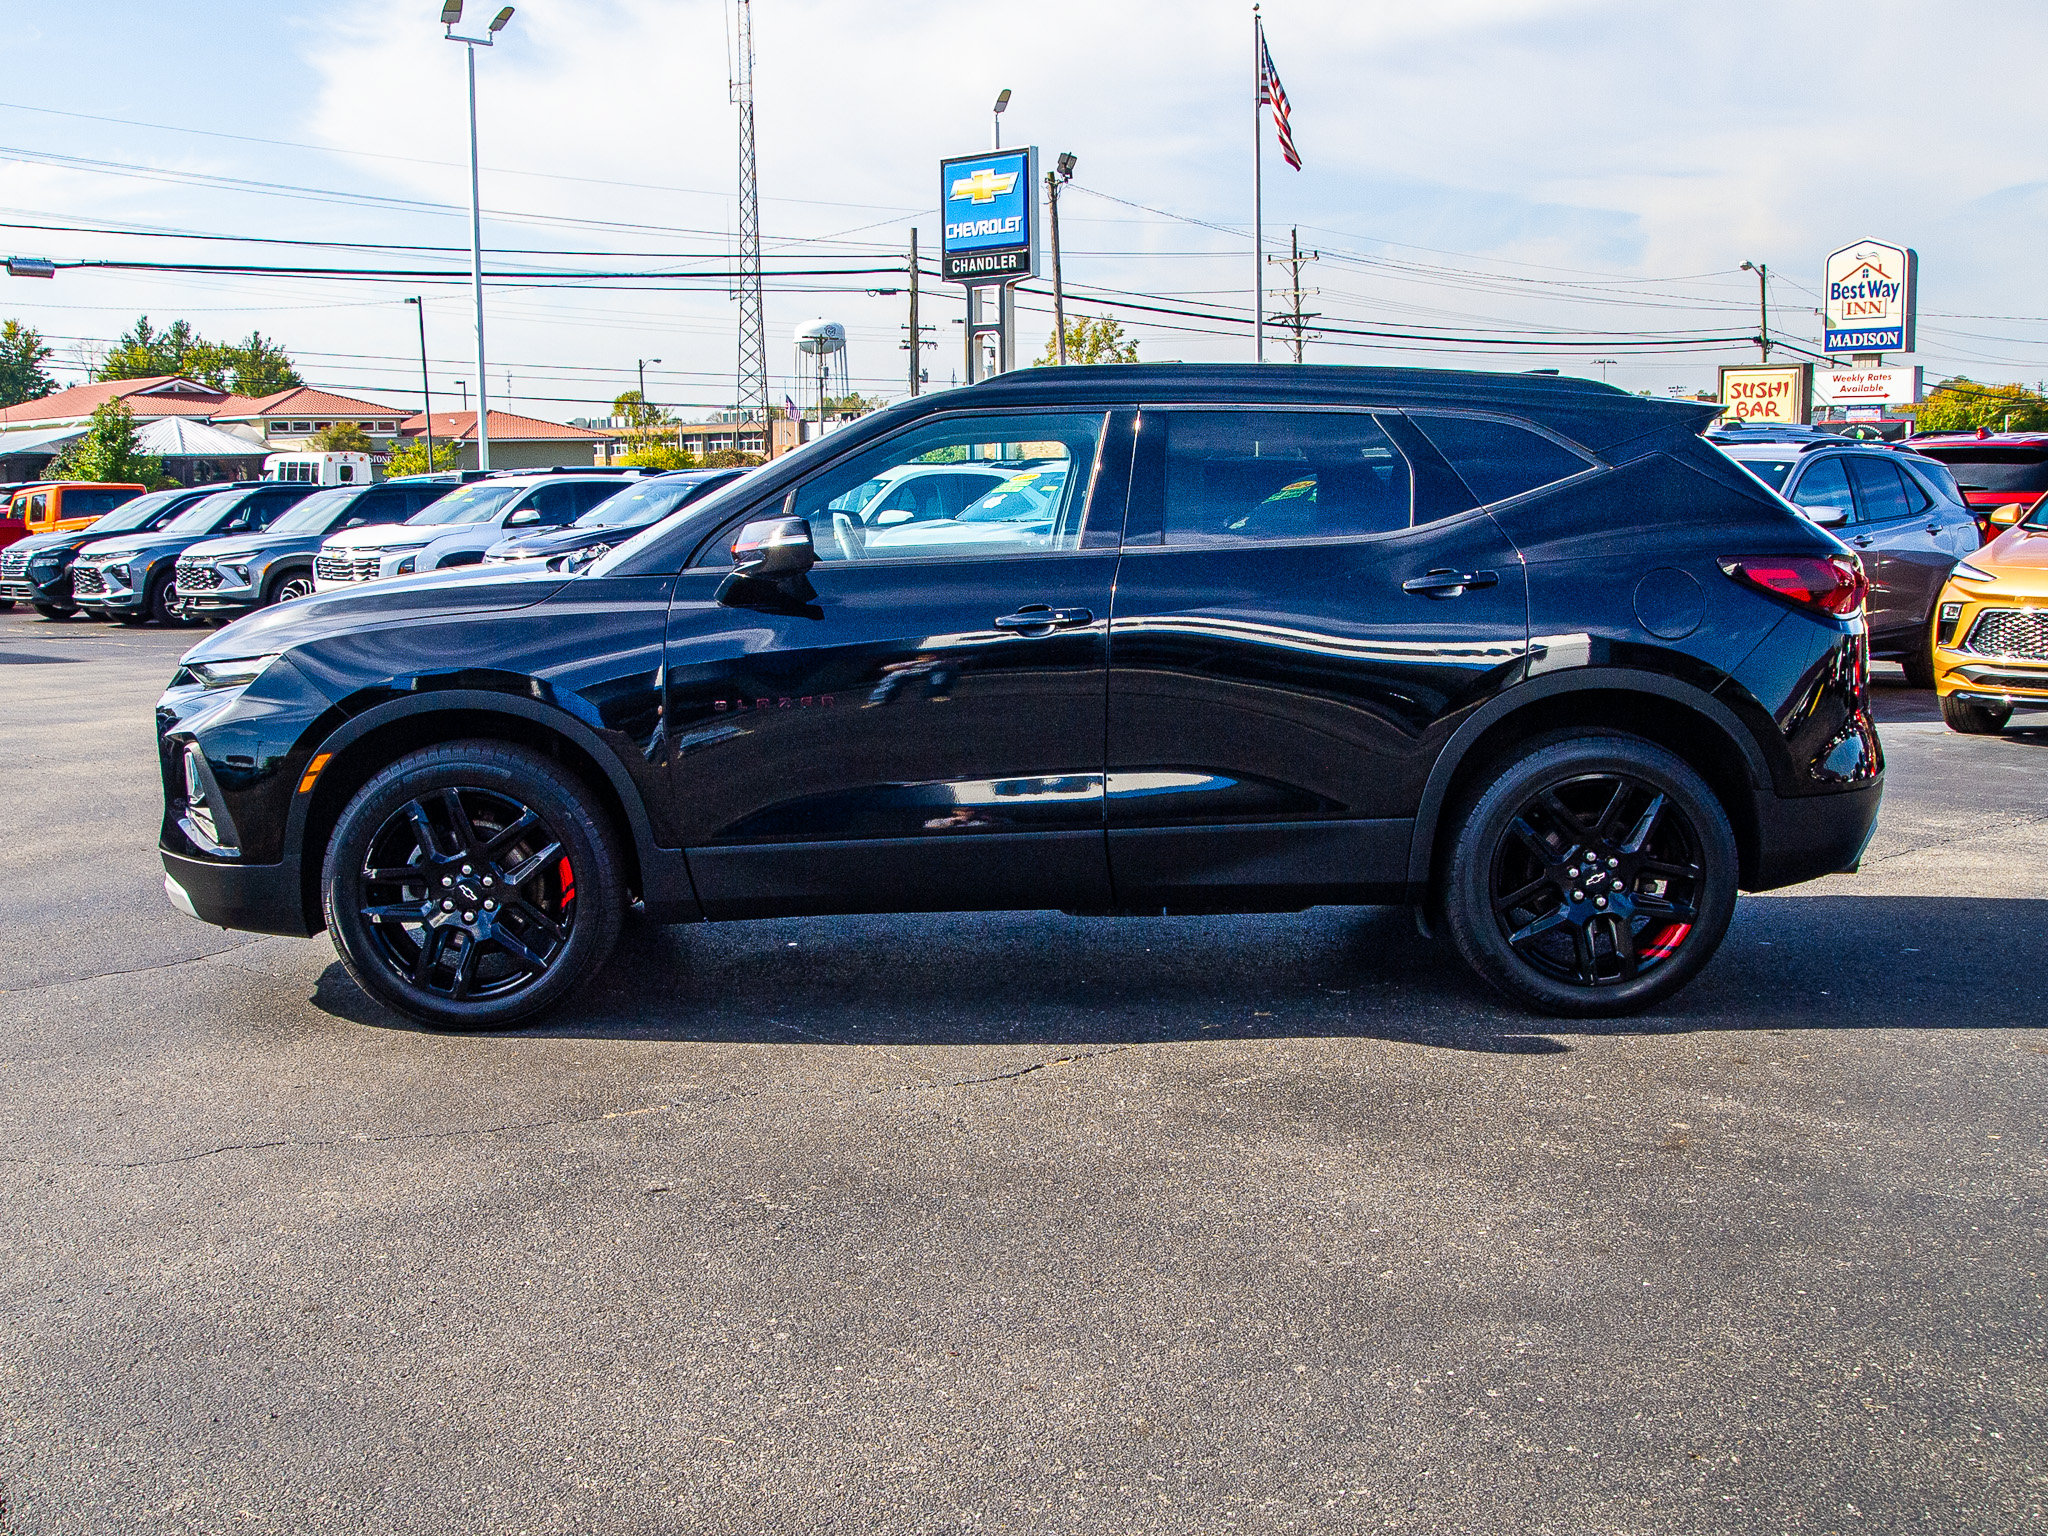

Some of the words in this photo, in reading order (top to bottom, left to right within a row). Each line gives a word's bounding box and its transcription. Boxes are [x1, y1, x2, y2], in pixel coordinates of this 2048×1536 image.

[946, 216, 1022, 239] CHEVROLET
[952, 255, 1017, 273] CHANDLER
[1830, 281, 1866, 300] Best
[1867, 280, 1901, 303] Way
[1845, 300, 1883, 316] INN
[1828, 331, 1899, 348] MADISON
[1832, 374, 1865, 383] Weekly
[1867, 373, 1892, 382] Rates
[1730, 381, 1789, 400] SUSHI
[1839, 383, 1884, 393] Available
[1735, 401, 1781, 418] BAR
